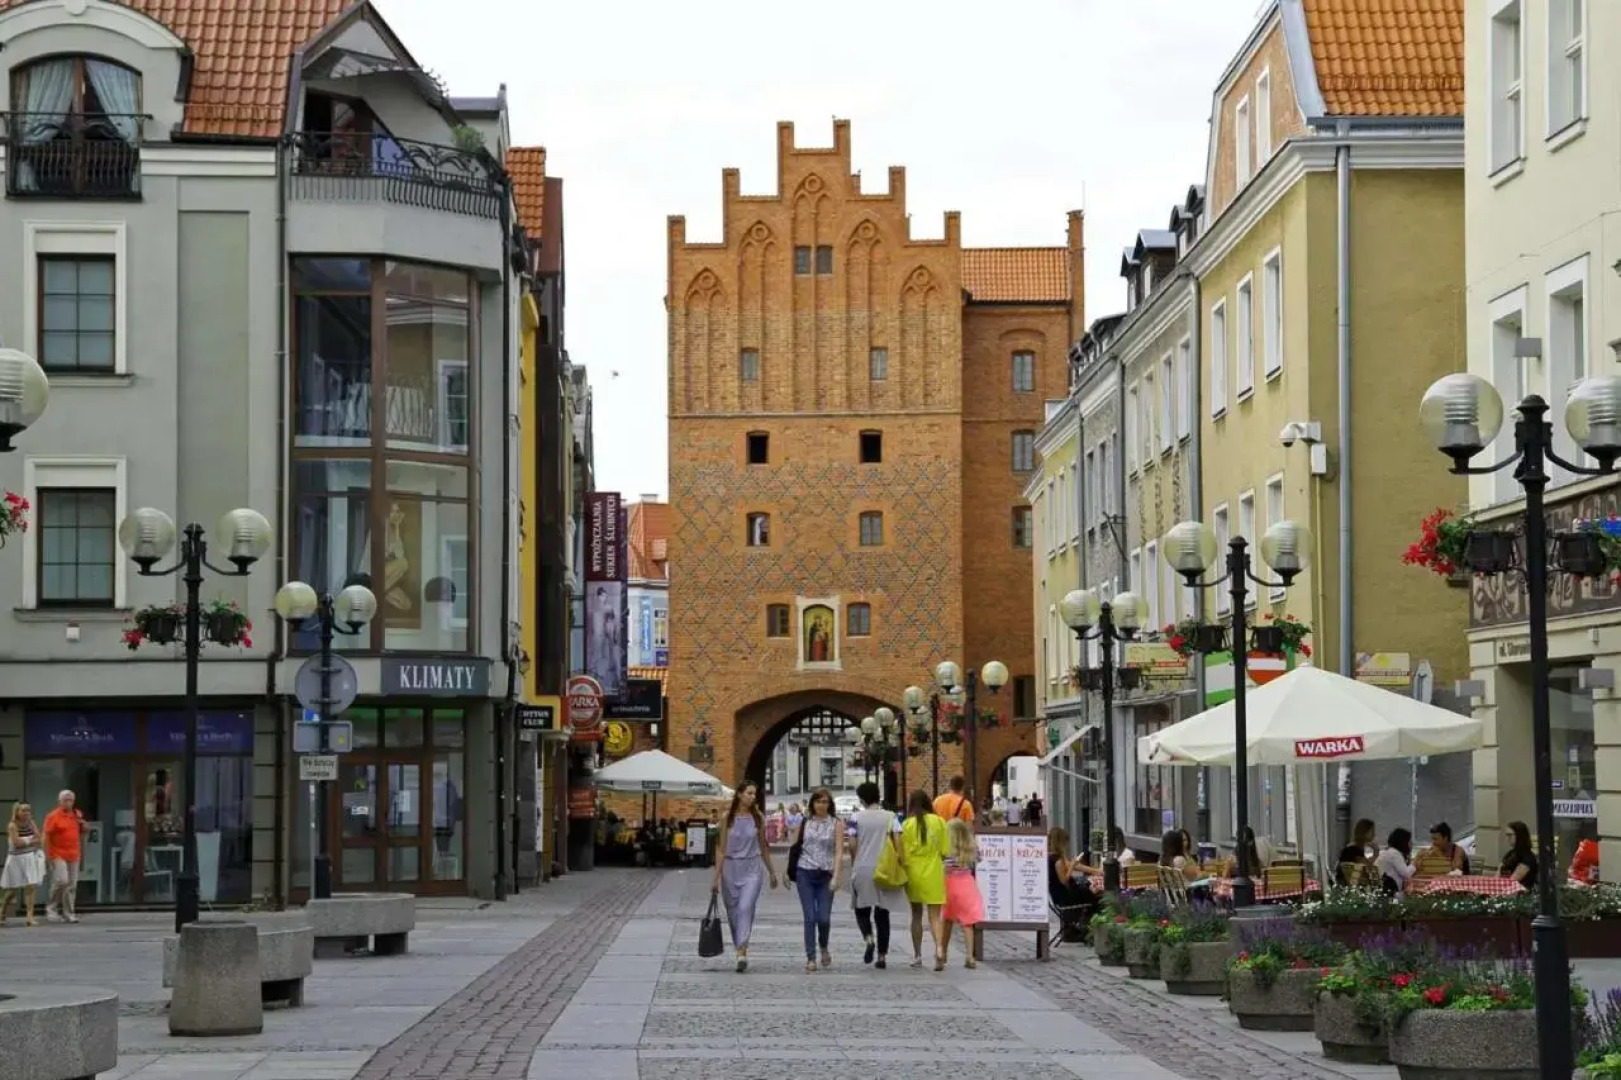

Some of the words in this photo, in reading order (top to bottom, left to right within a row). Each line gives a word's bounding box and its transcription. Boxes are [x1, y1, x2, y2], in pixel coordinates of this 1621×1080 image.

[606, 545, 616, 579] SUKIEN
[399, 665, 476, 689] KLIMATY
[570, 696, 600, 709] ARKA
[1297, 738, 1361, 755] WARKA
